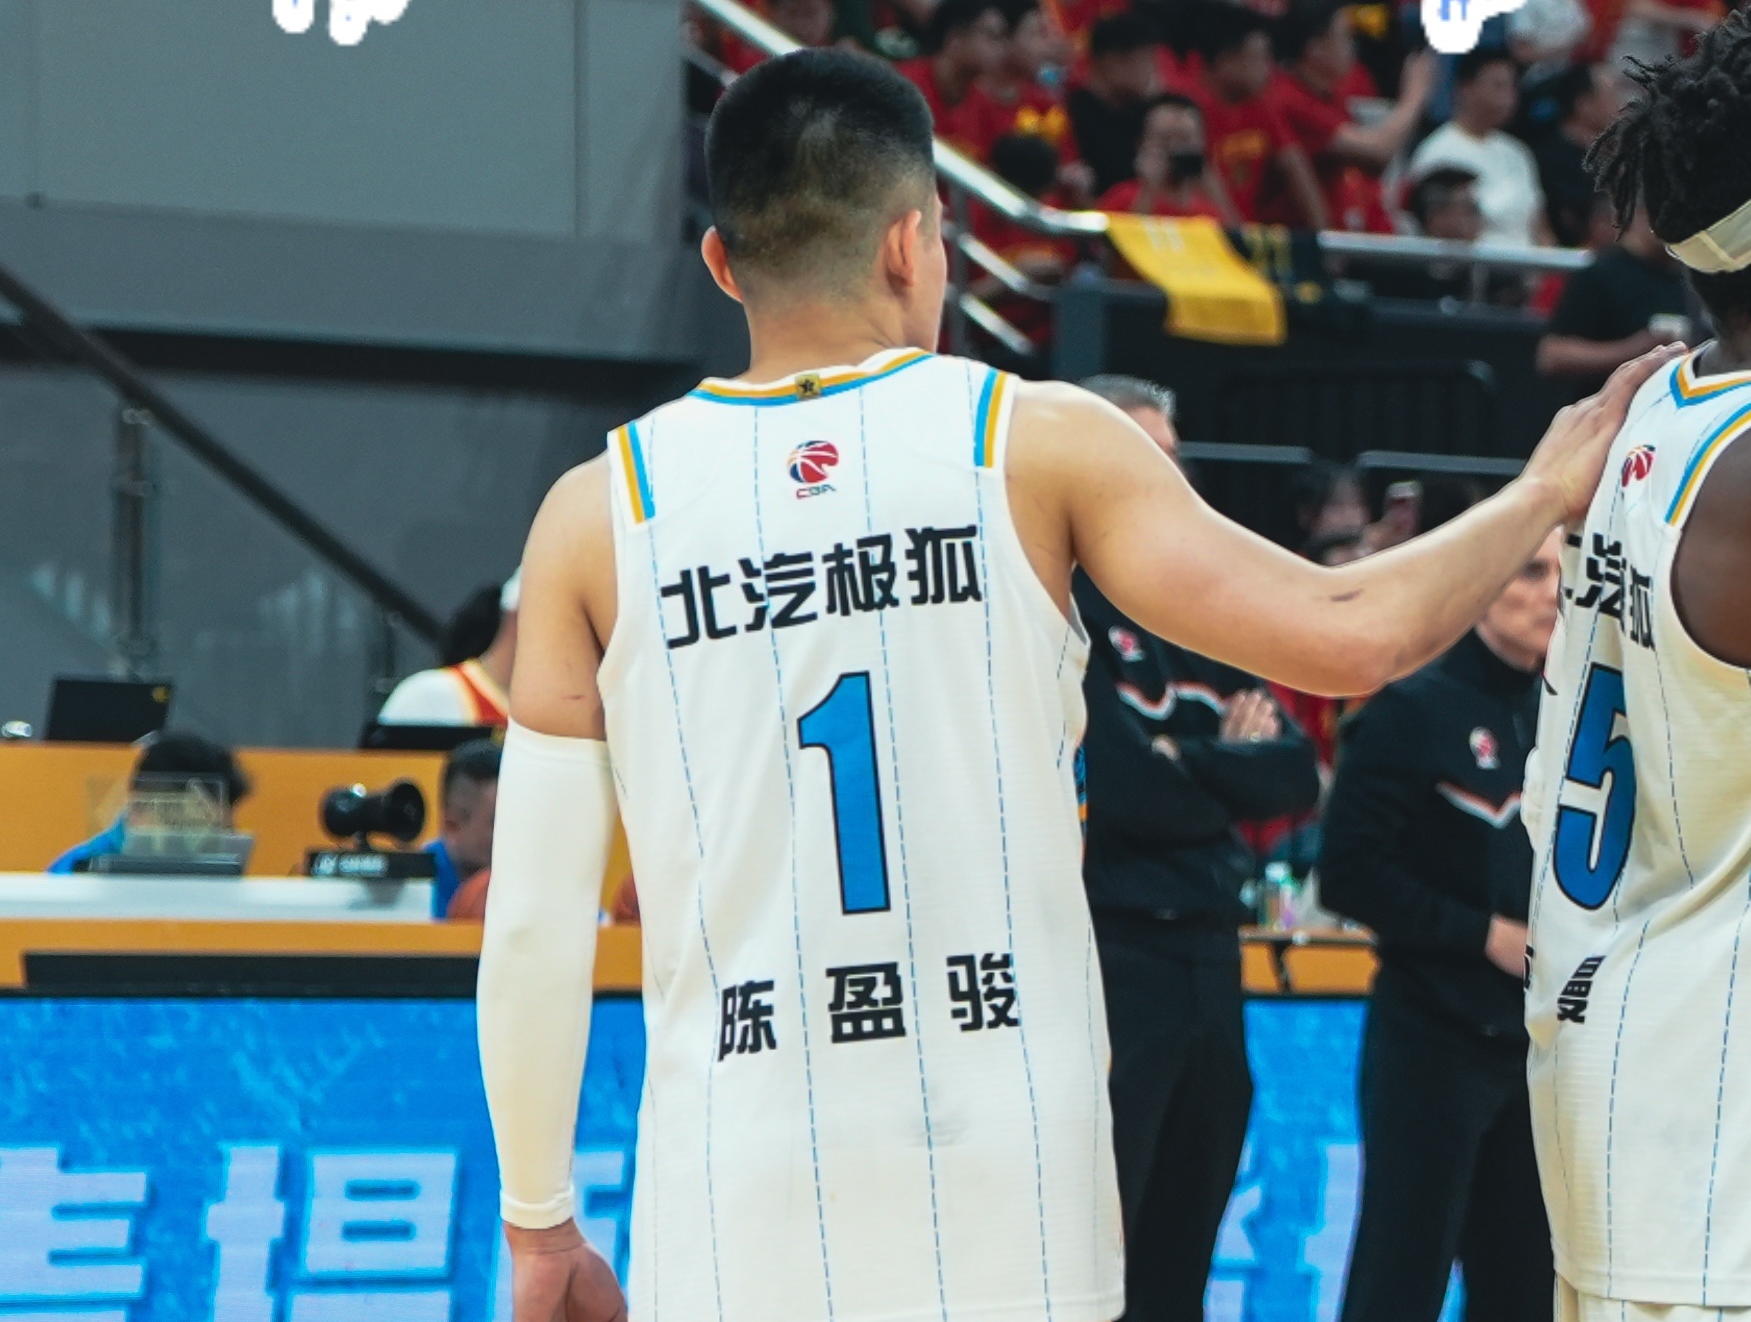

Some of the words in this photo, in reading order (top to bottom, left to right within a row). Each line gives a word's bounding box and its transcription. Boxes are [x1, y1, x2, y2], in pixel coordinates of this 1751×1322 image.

[661, 525, 986, 650] 北汽极狐
[796, 671, 892, 917] 1
[717, 952, 1021, 1062] 陈盈骏
